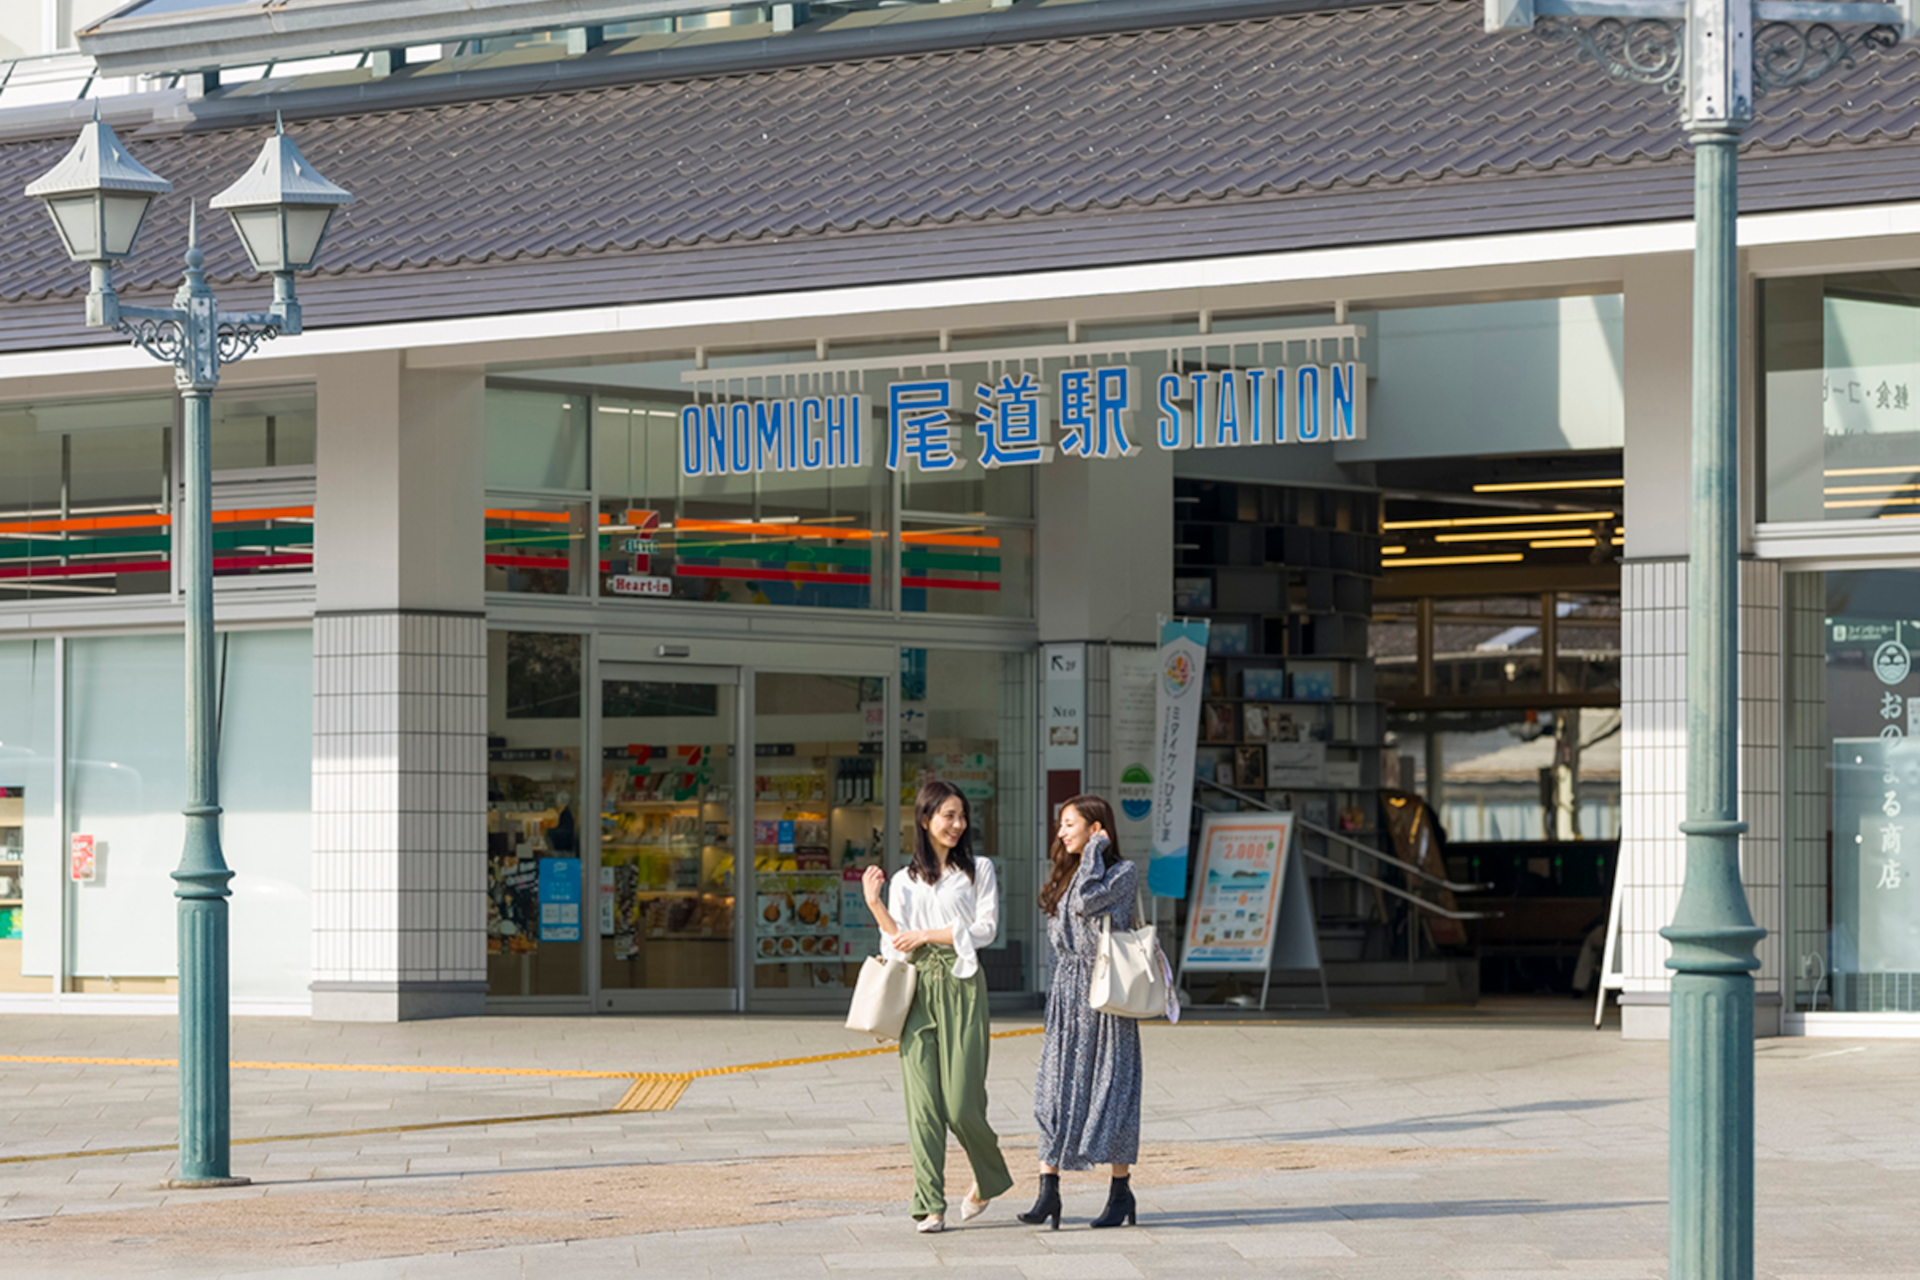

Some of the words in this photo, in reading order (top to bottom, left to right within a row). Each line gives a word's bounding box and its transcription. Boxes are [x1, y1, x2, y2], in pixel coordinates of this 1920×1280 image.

[681, 393, 863, 478] ONOMICHI
[885, 364, 1132, 471] 尾道駅
[1157, 361, 1357, 451] STATION
[616, 577, 669, 593] Heart-in
